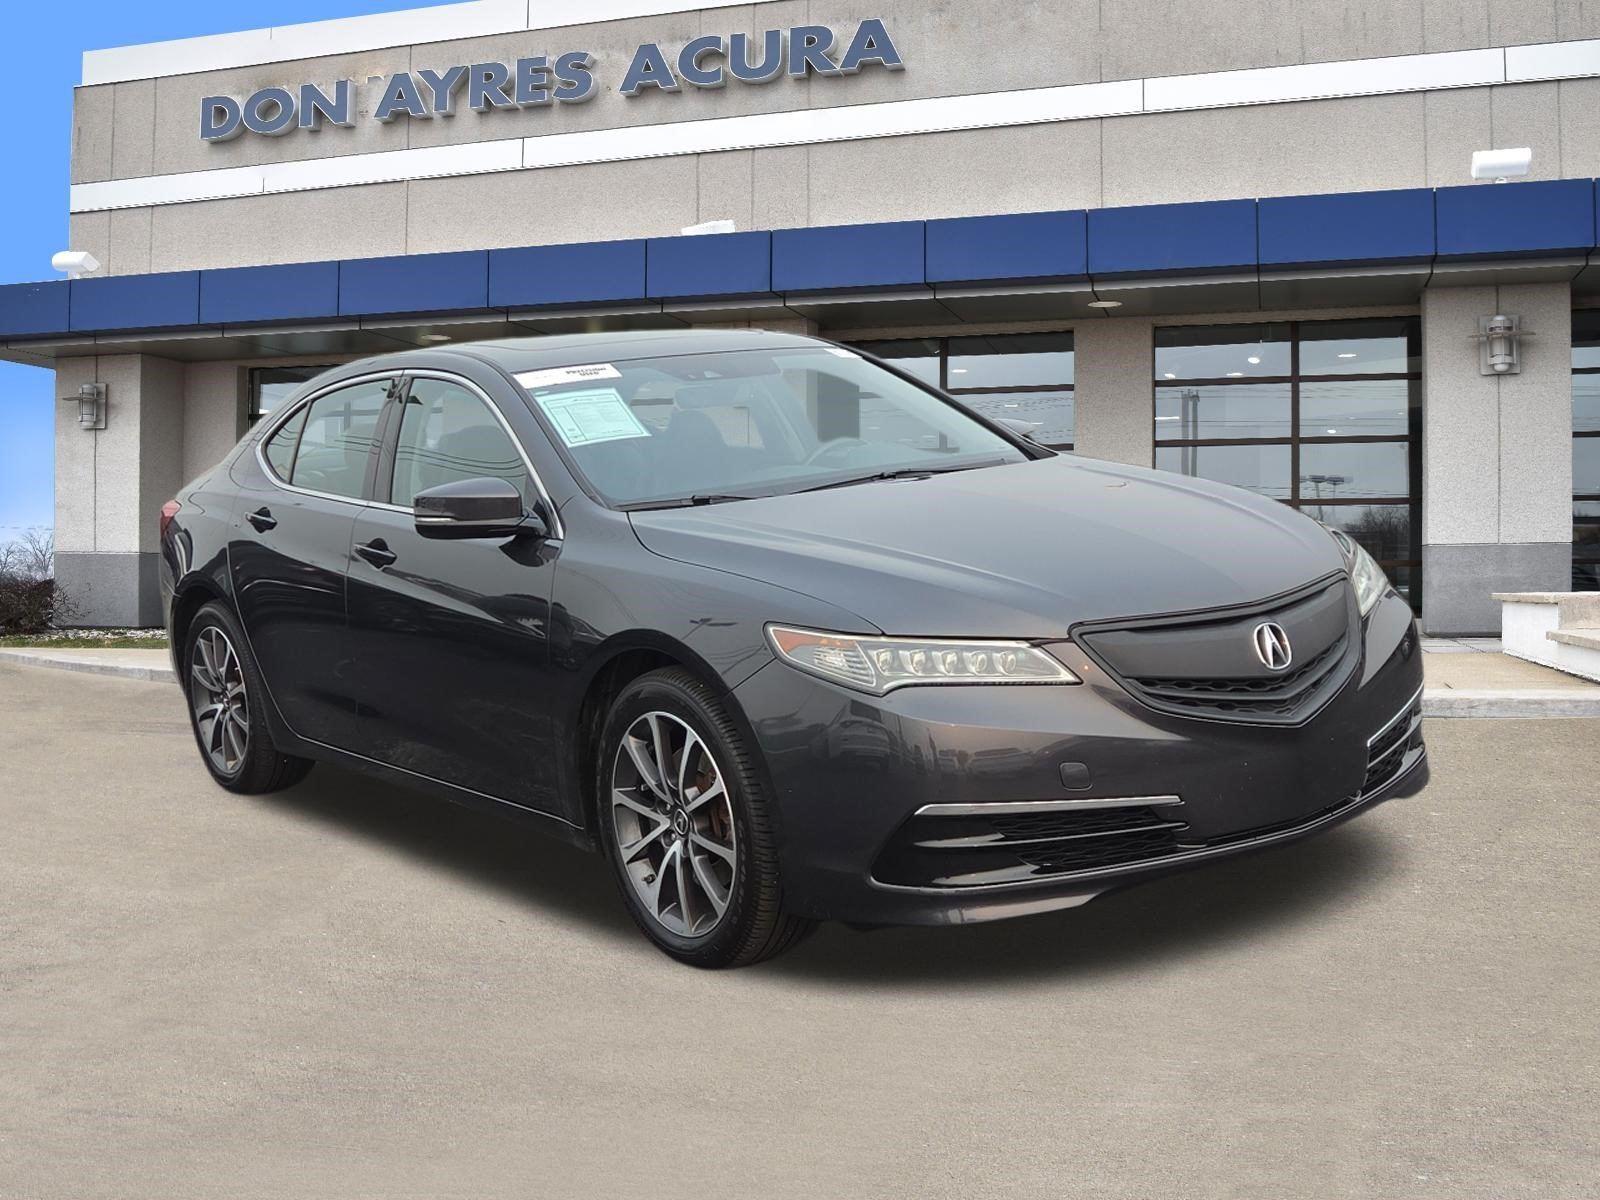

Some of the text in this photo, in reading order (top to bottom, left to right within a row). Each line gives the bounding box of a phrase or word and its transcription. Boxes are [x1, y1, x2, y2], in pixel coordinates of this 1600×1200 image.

[200, 18, 905, 142] DON AYRES ACURA
